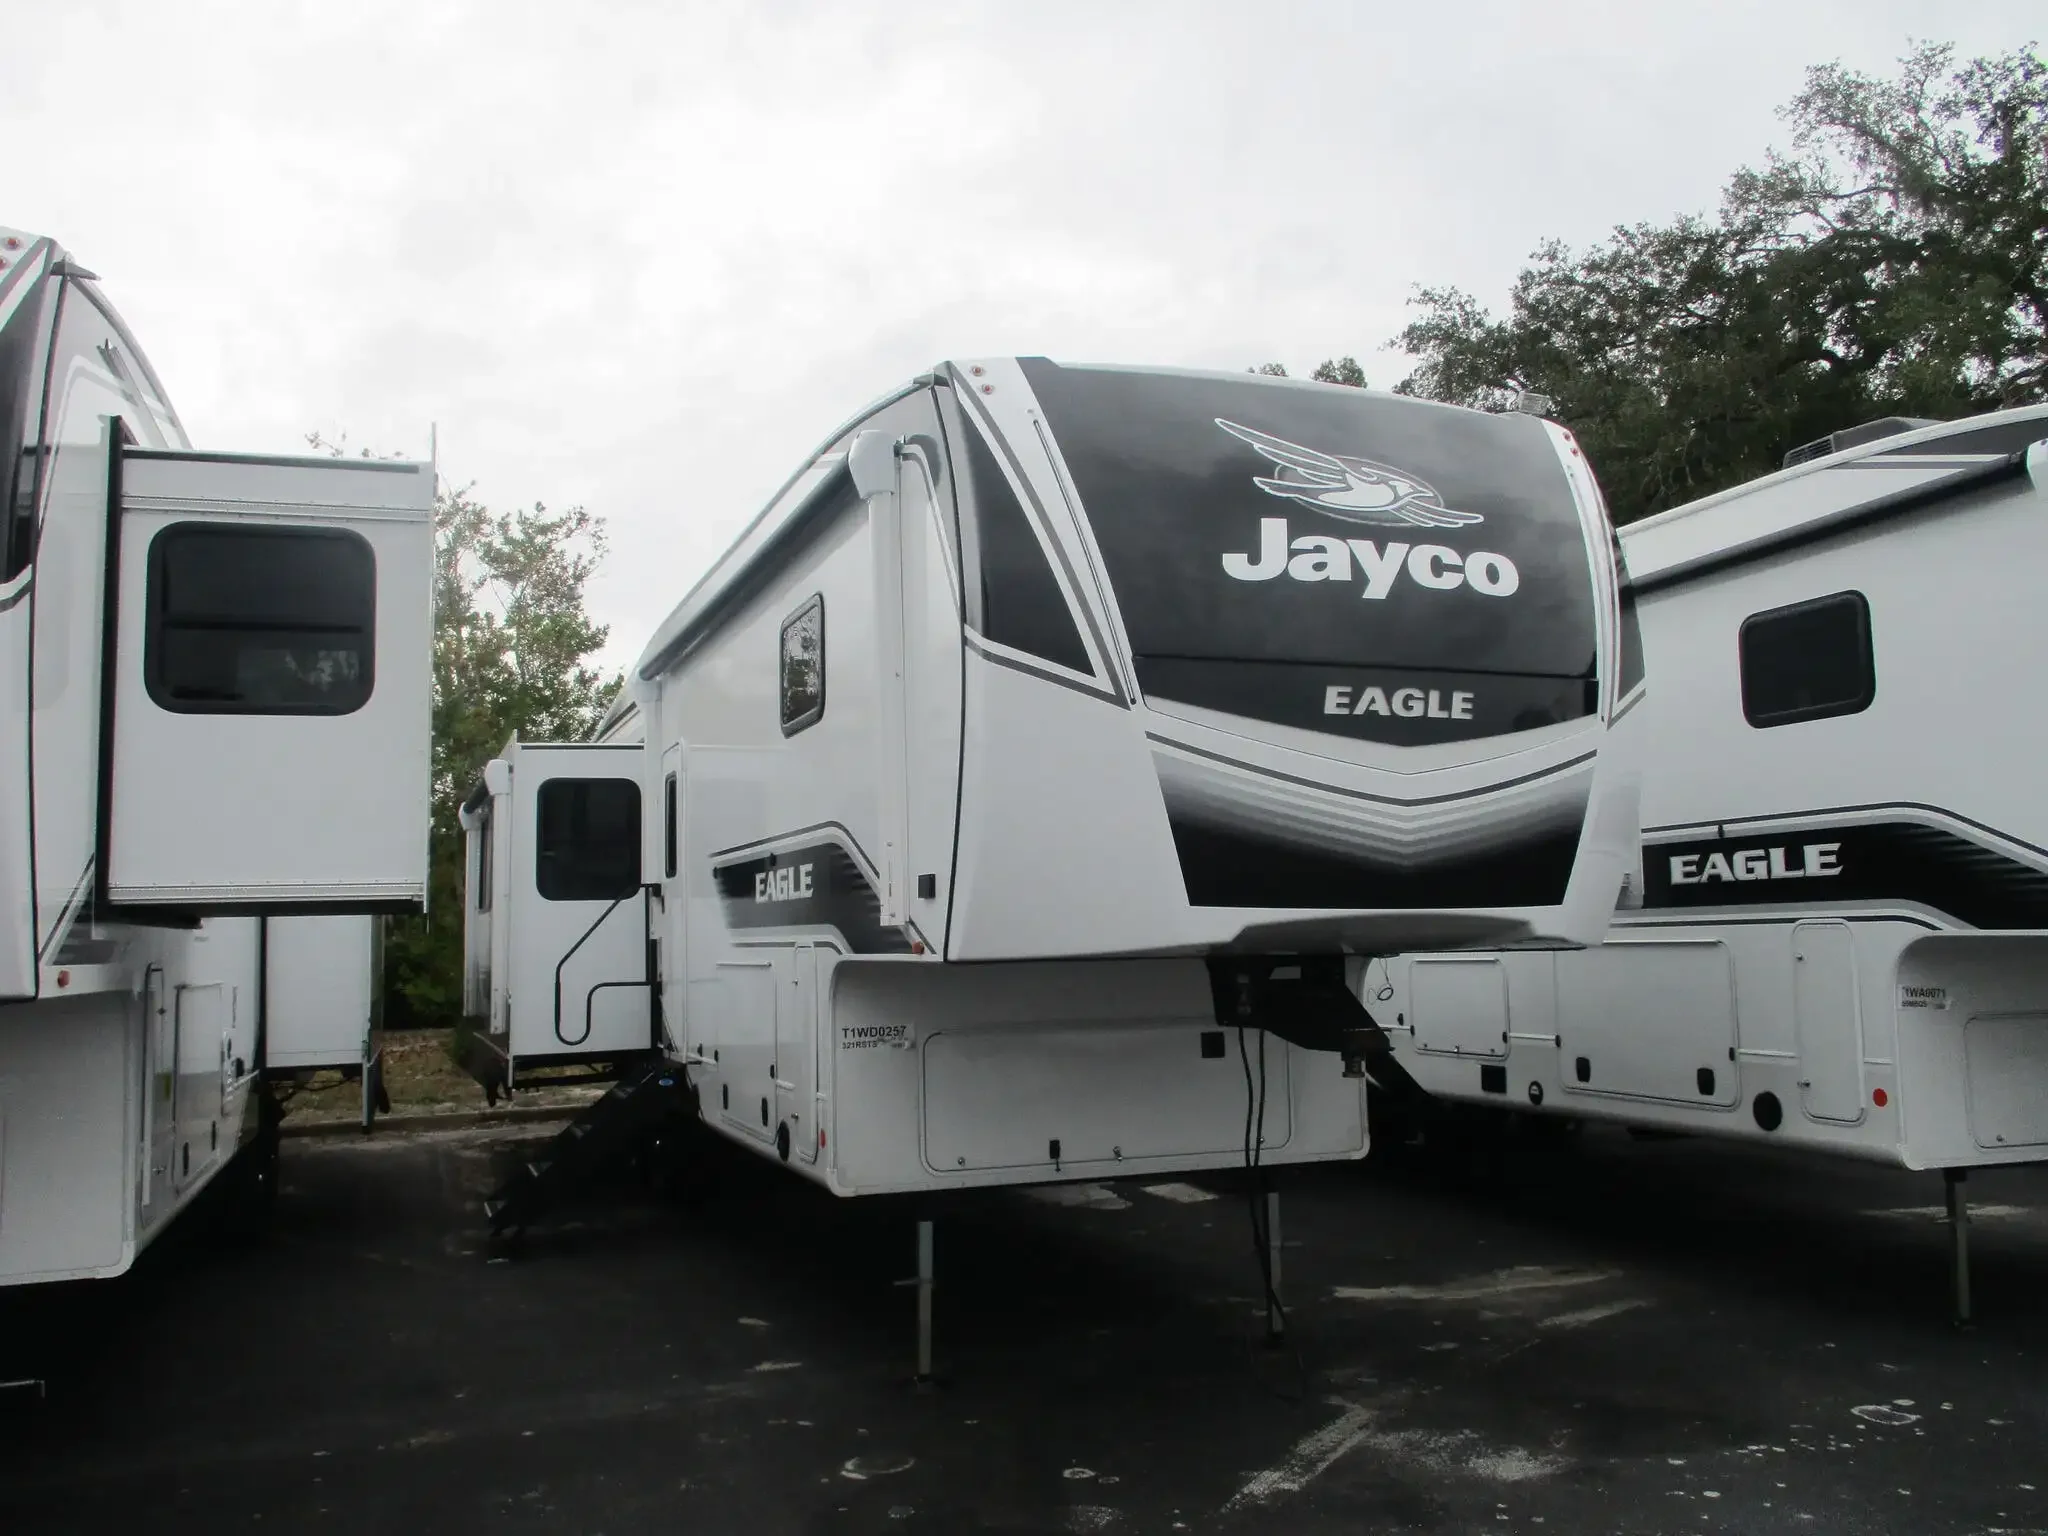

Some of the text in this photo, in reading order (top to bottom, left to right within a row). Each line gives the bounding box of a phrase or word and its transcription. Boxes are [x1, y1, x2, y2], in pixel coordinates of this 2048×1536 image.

[1222, 518, 1519, 600] Jayco
[1323, 685, 1475, 720] EAGLE
[755, 863, 814, 904] EAGLE
[1669, 842, 1844, 886] EAGLE
[841, 1025, 907, 1039] T1WD0257
